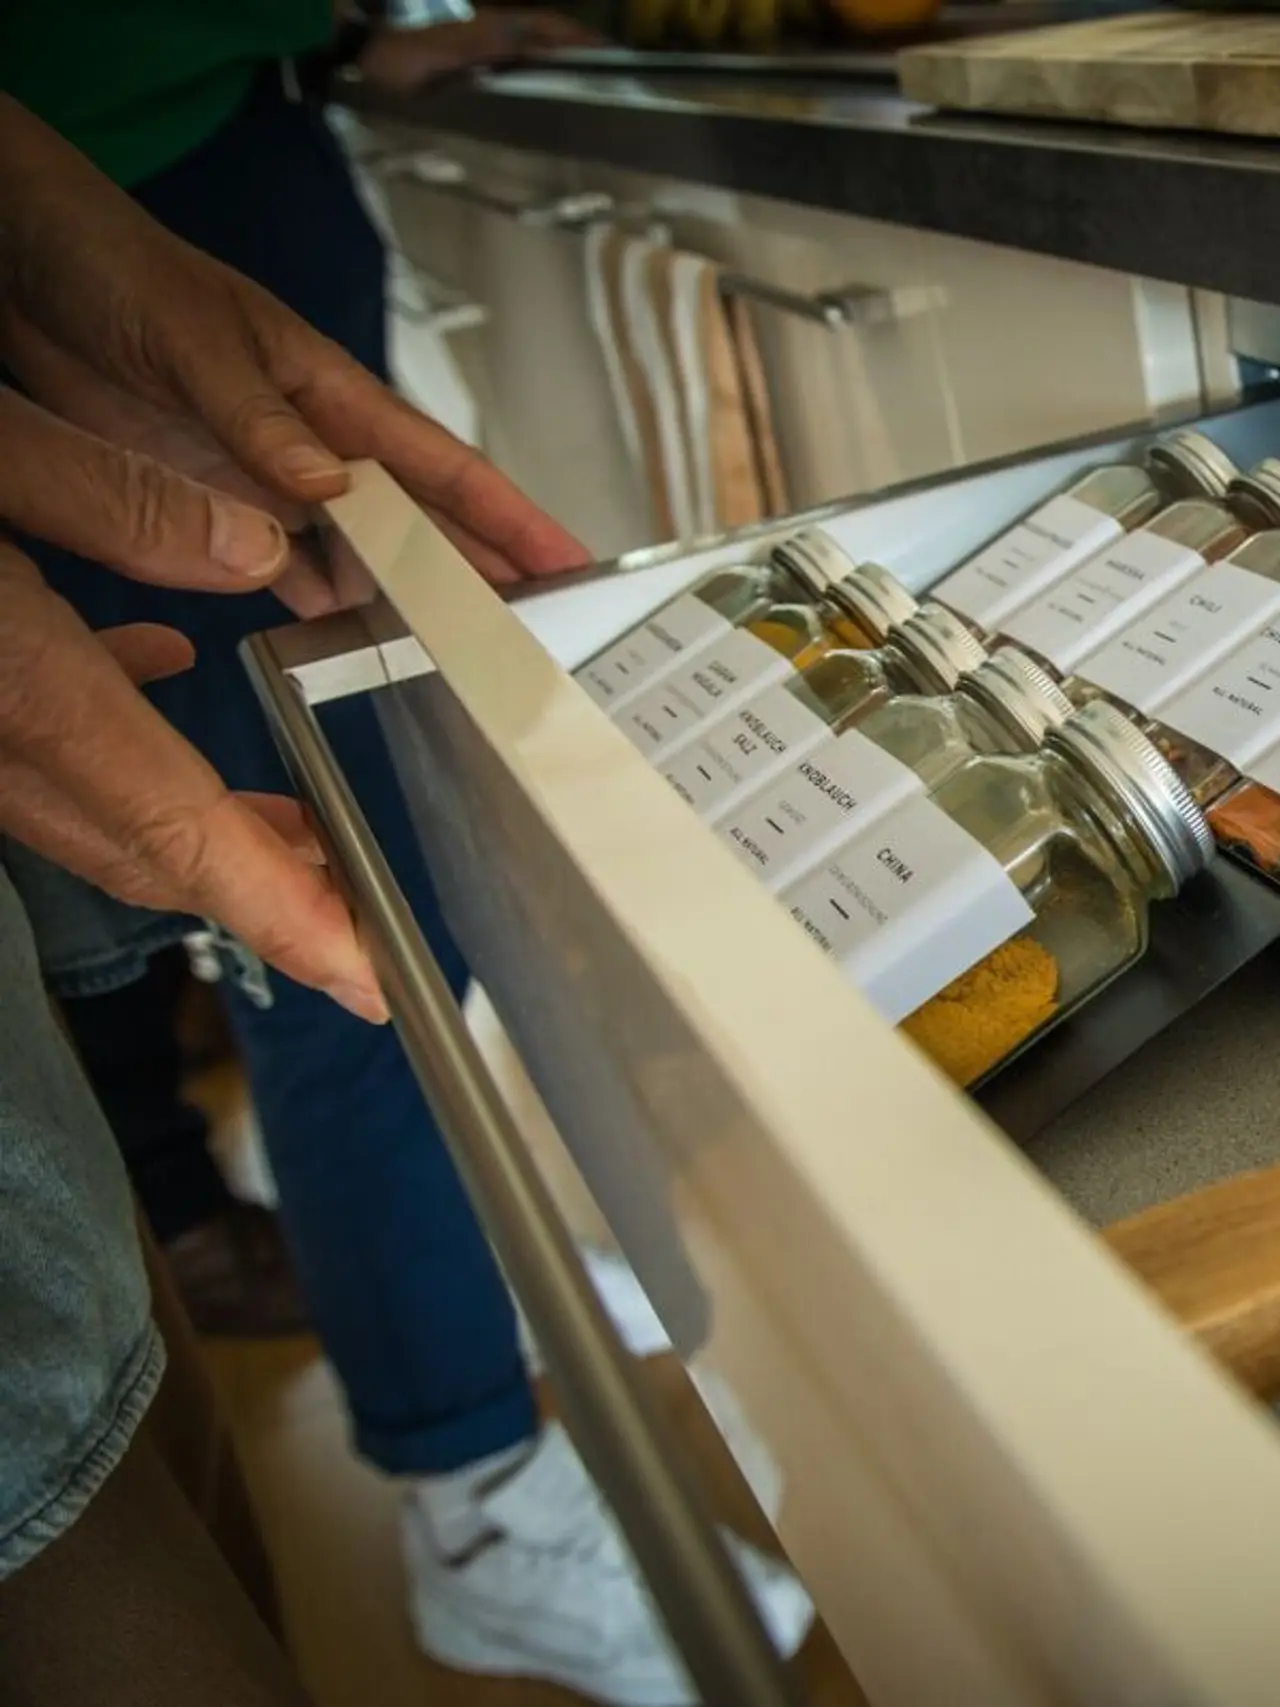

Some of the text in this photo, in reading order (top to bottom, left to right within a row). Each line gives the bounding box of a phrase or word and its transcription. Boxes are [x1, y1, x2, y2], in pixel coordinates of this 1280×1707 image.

[1189, 594, 1223, 614] CHILI
[731, 732, 758, 756] SALZ
[739, 709, 788, 754] KNOBLAUCH
[798, 761, 858, 811] KNOBLAUCH
[876, 847, 914, 884] CHINA
